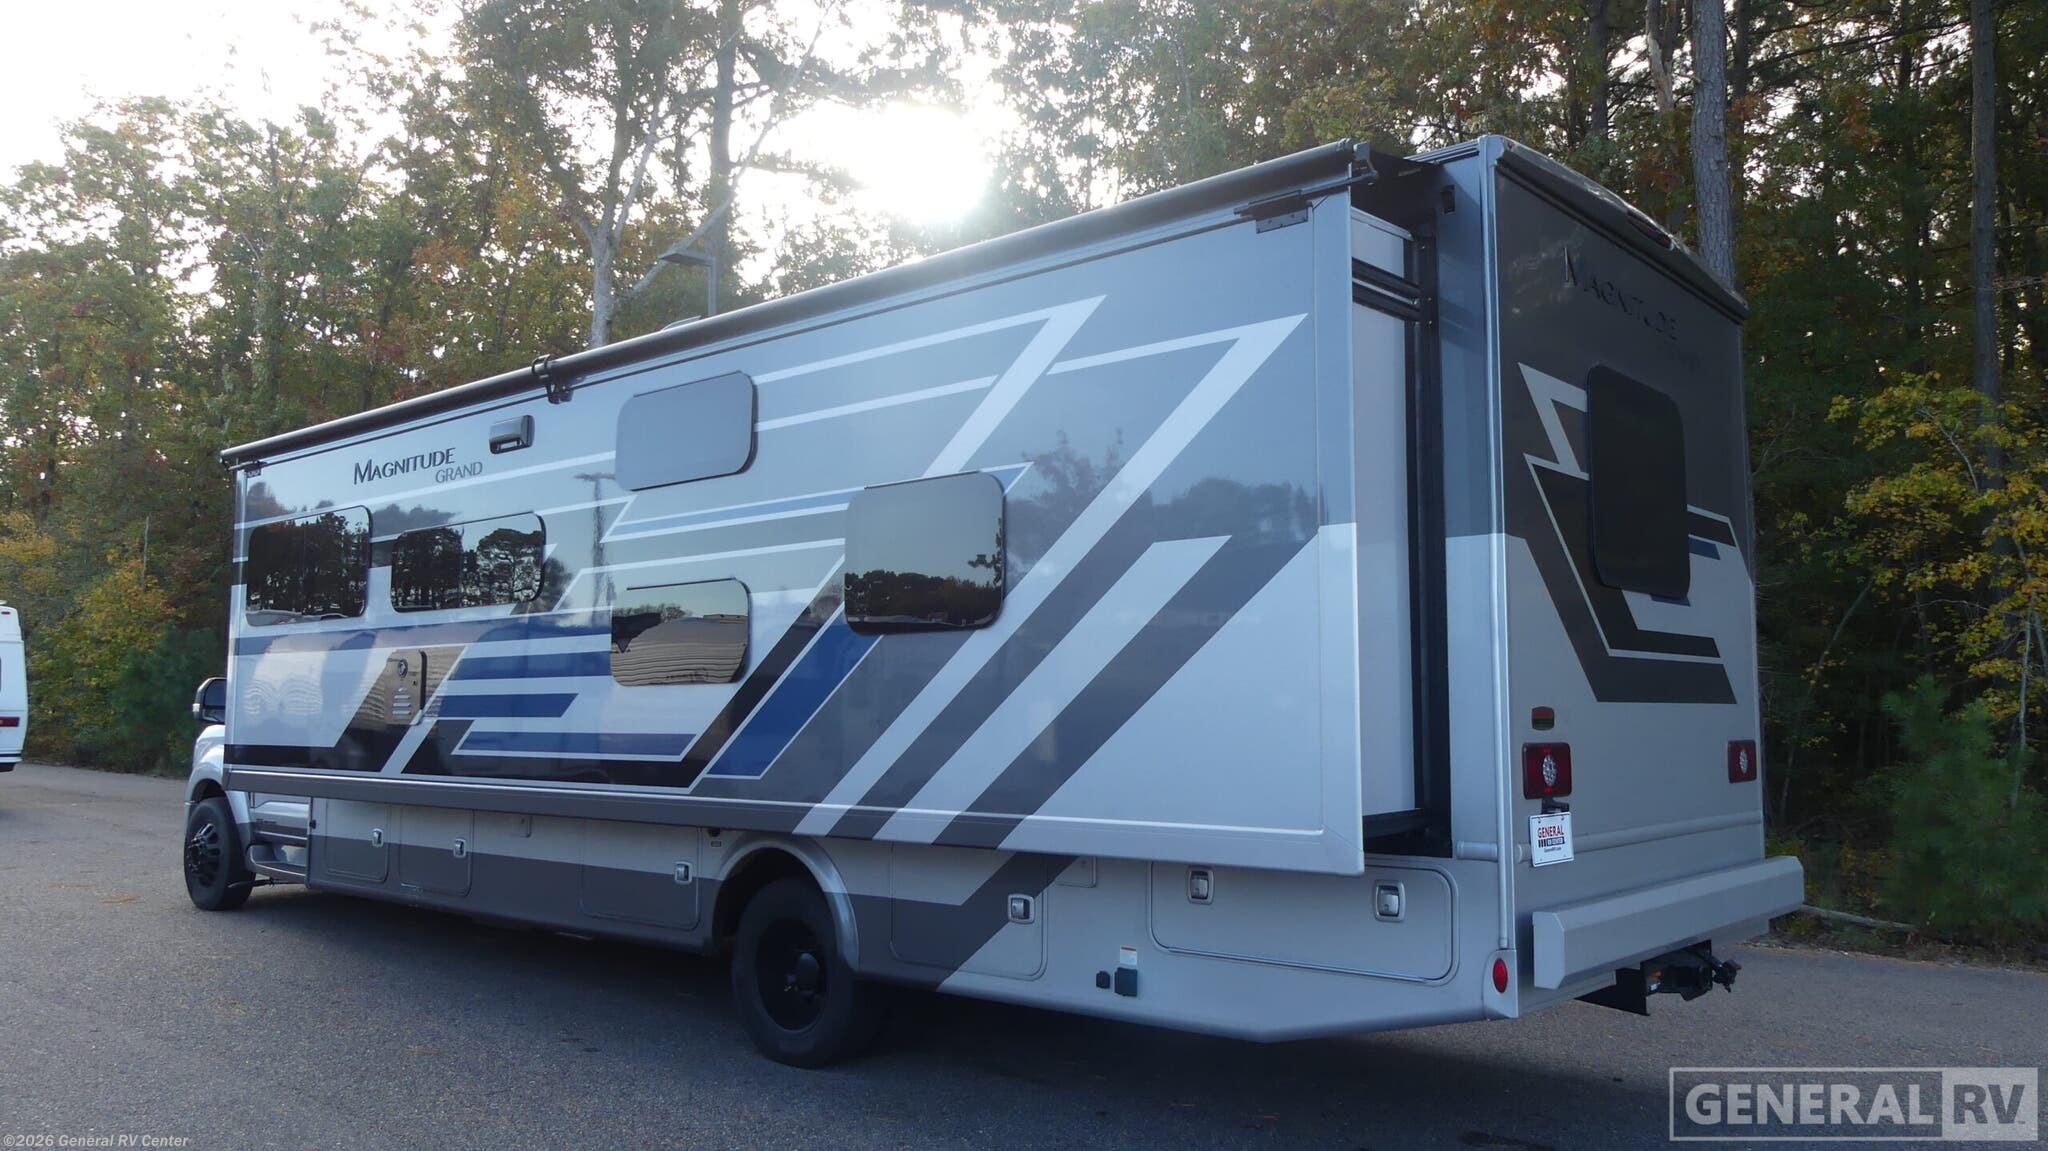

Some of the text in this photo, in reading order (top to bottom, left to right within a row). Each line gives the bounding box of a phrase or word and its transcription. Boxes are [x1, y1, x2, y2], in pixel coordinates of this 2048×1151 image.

[353, 447, 457, 486] MAGNITUDE
[435, 461, 483, 484] GRAND
[1537, 825, 1565, 839] GENERAL
